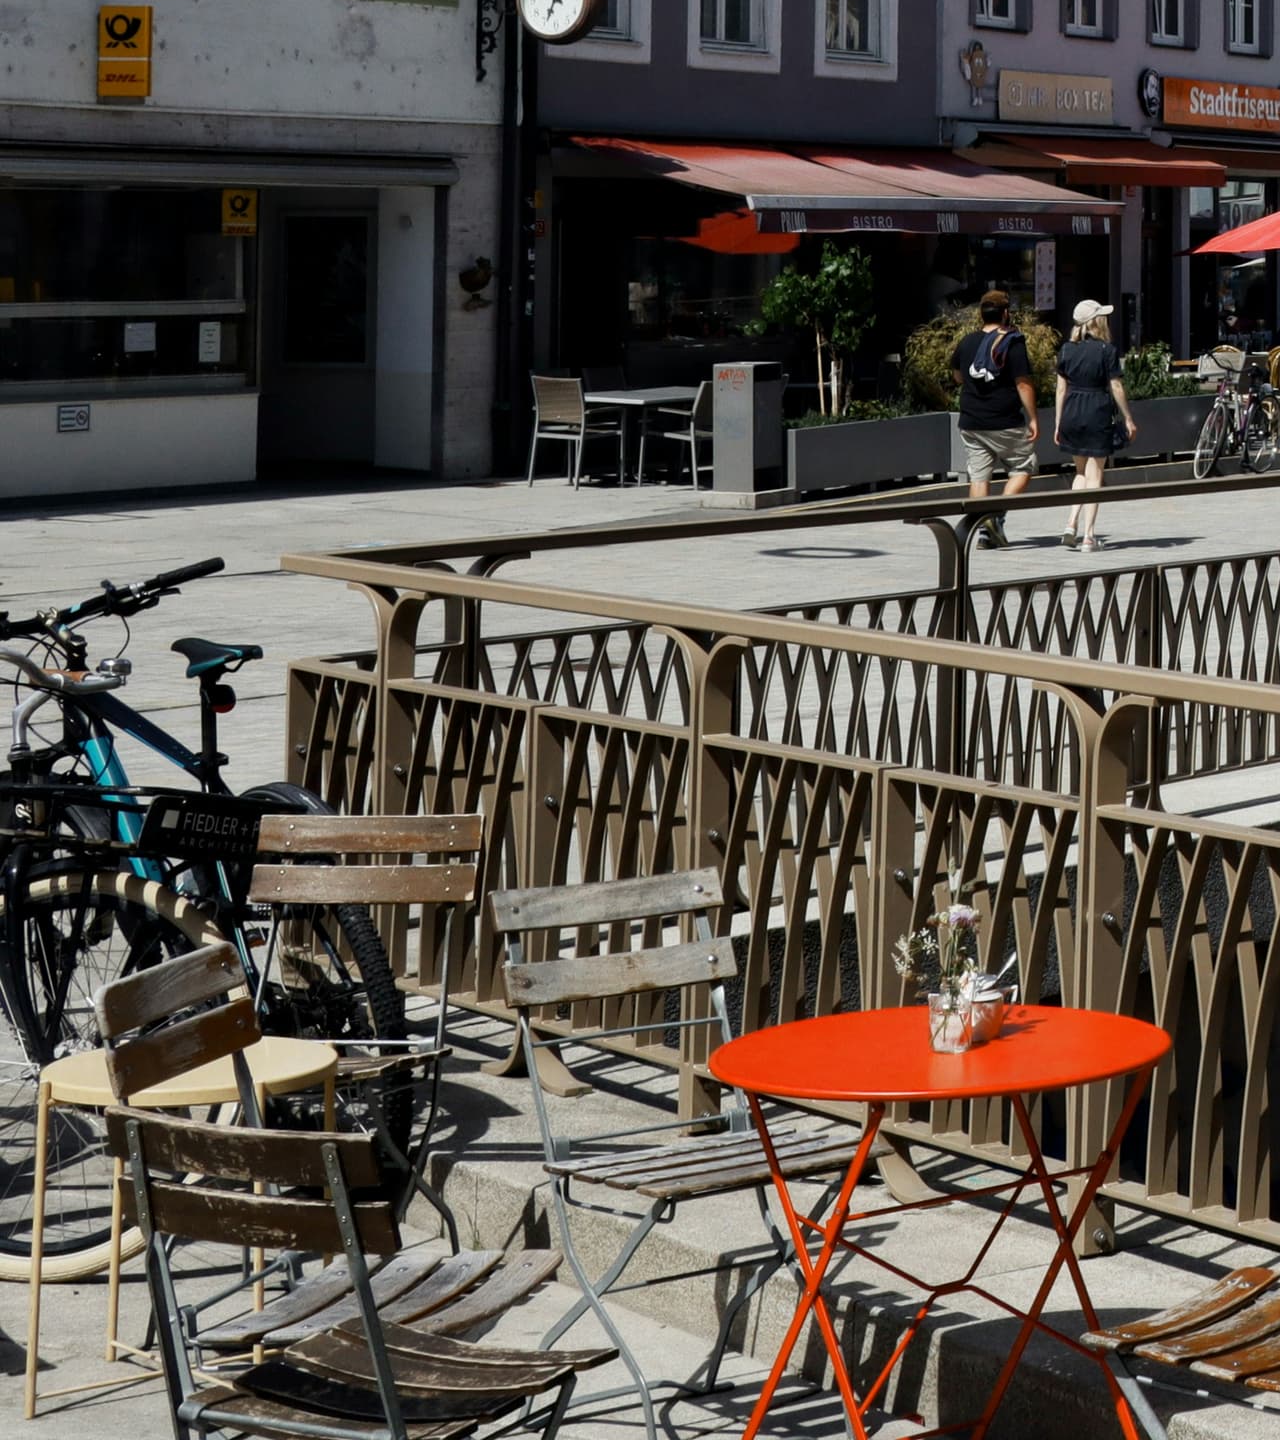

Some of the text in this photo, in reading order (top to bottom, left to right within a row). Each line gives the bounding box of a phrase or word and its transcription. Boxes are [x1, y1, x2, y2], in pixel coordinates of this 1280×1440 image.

[104, 73, 138, 83] DHL
[1056, 88, 1079, 111] BOX
[1084, 90, 1107, 112] TEA
[1189, 86, 1280, 120] Stadtfriseur
[780, 211, 807, 233] PRIMO
[852, 215, 893, 229] BISTRO
[936, 213, 959, 233] PRIMO
[999, 217, 1033, 230] BISTRO
[183, 812, 239, 836] FIEDLER
